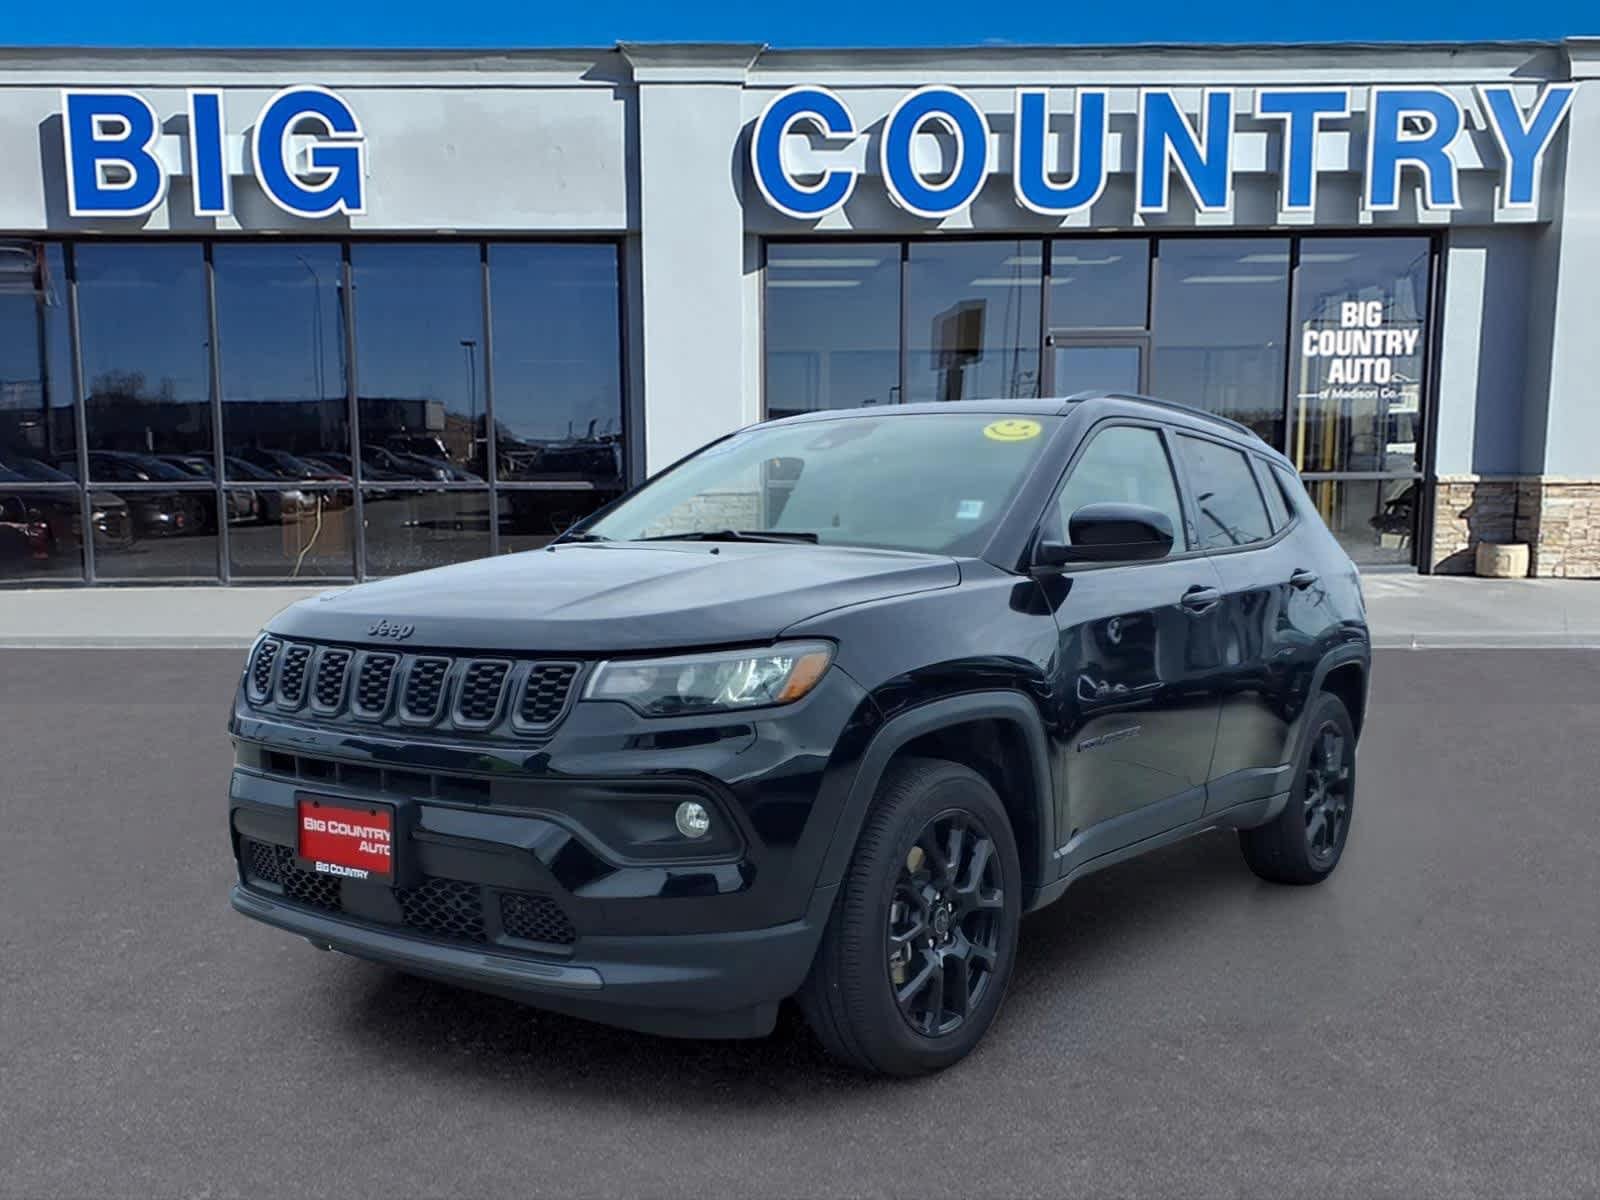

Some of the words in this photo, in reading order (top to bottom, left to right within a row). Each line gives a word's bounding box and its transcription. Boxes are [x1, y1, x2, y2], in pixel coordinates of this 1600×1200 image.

[61, 85, 366, 219] BIG
[750, 84, 1576, 220] COUNTRY
[1340, 301, 1383, 328] BIG
[1302, 329, 1419, 357] COUNTRY
[1328, 357, 1391, 385] AUTO
[1331, 388, 1378, 399] Madison
[367, 617, 415, 642] Jeep
[303, 817, 326, 832] BIG
[328, 821, 391, 842] COUNTRY
[315, 861, 329, 873] BIG
[330, 863, 369, 879] COUNTRY
